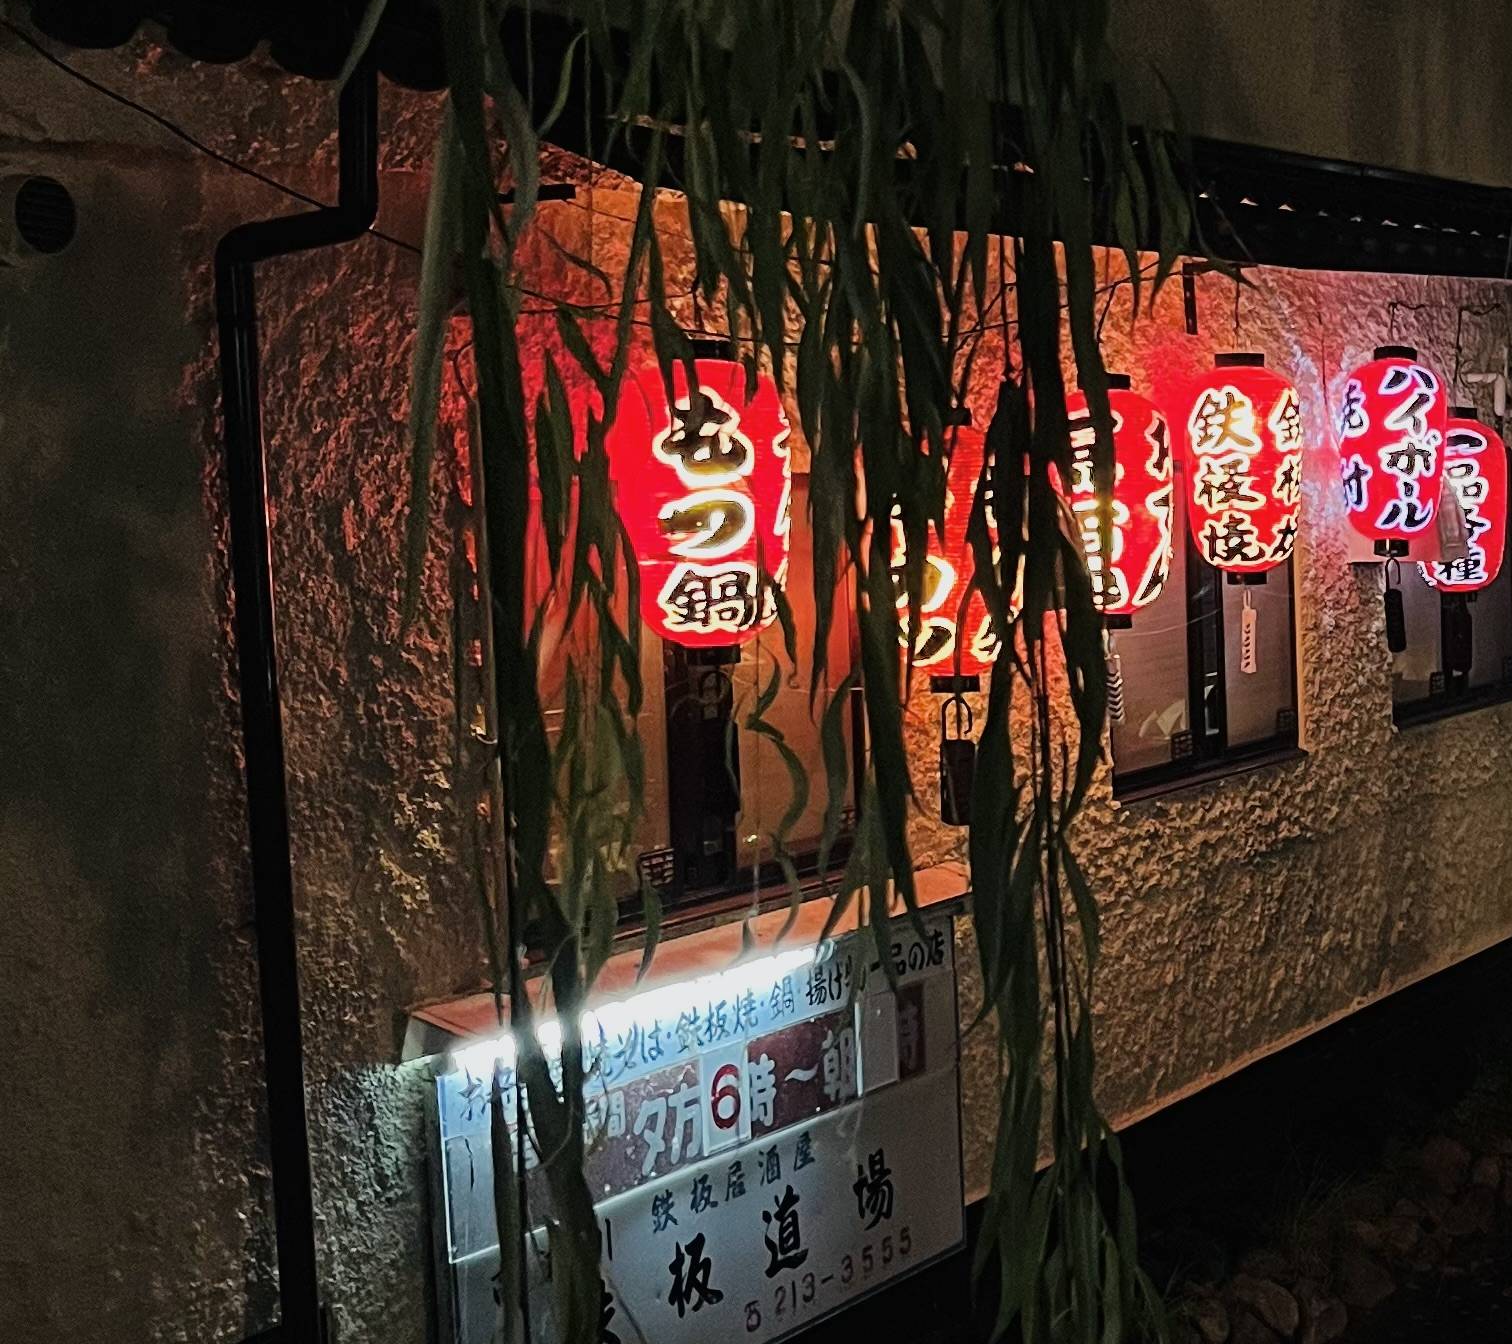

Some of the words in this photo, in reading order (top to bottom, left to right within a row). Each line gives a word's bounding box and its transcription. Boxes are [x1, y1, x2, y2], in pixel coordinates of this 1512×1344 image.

[653, 387, 757, 633] もつ鍋
[1190, 388, 1267, 565] 鉄板焼
[1377, 366, 1441, 530] ハイボール
[651, 1131, 815, 1234] 鉄板居酒屋
